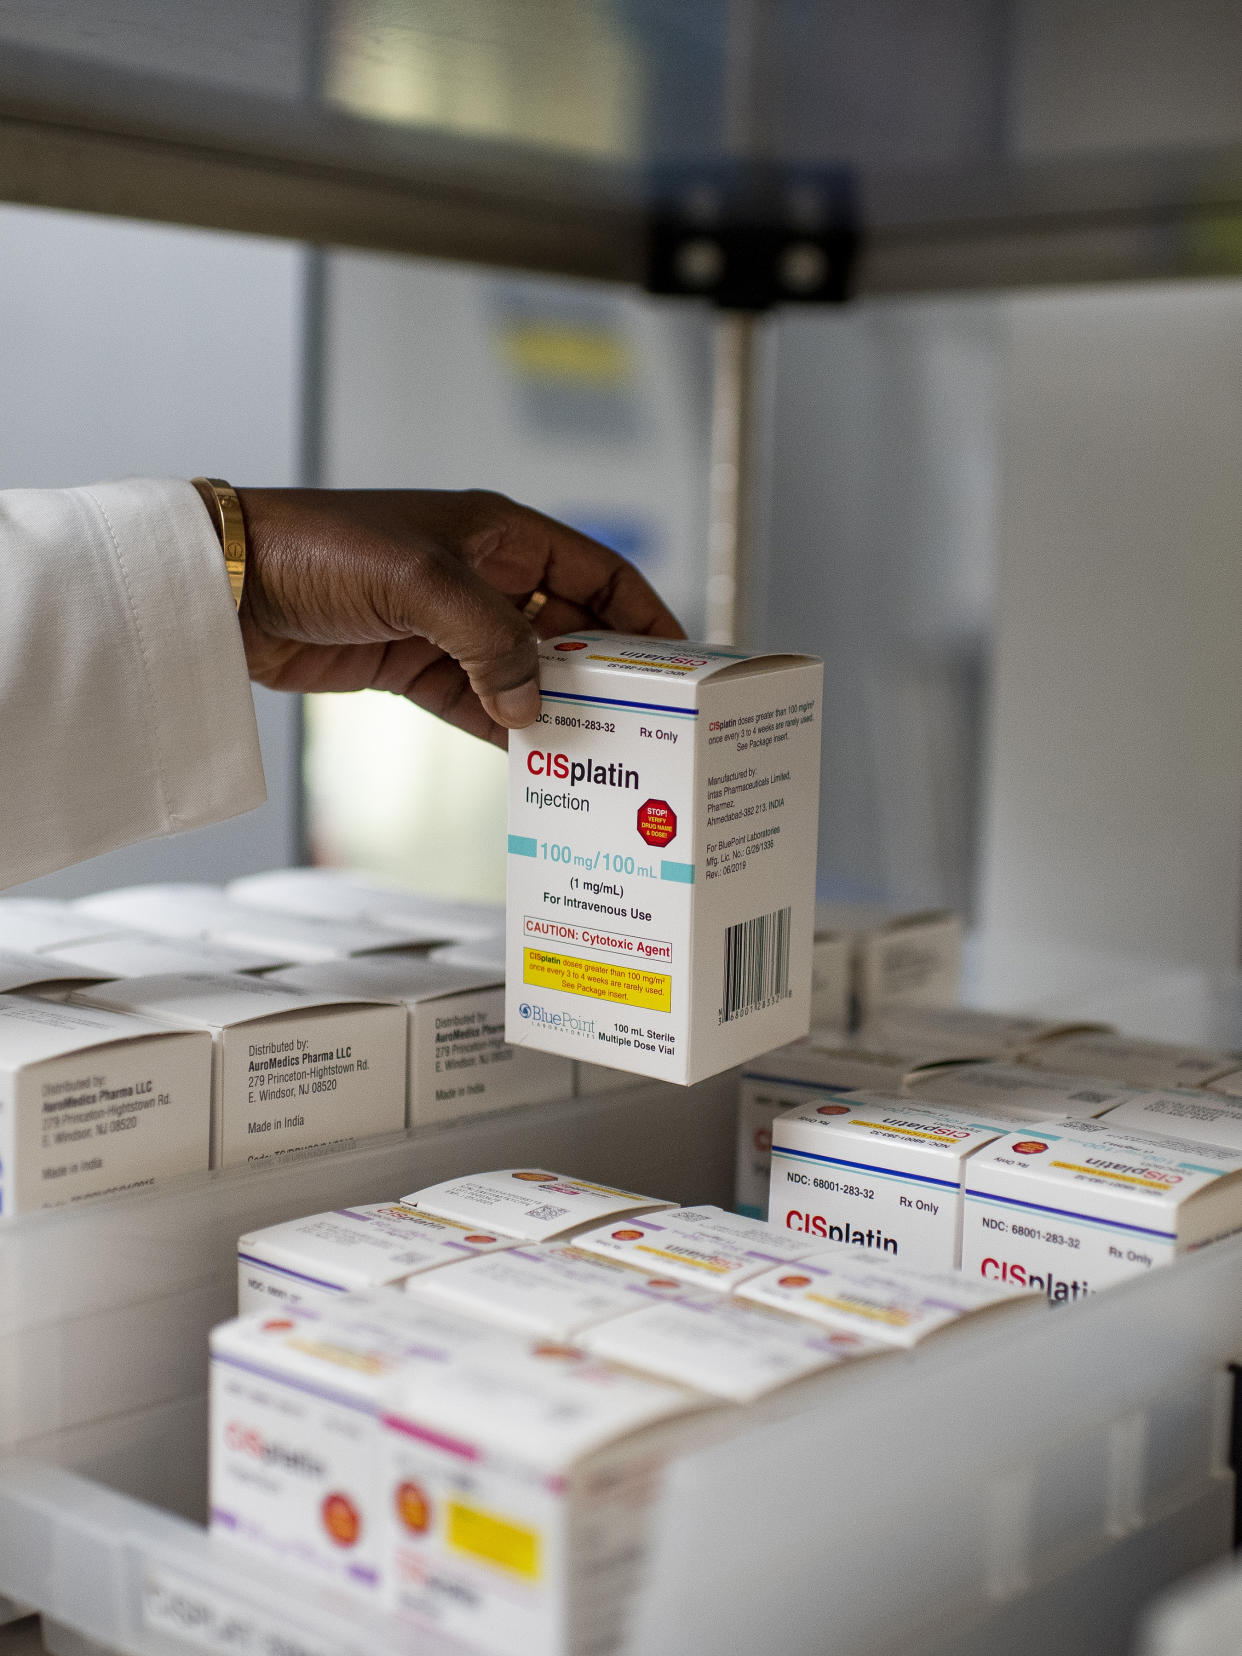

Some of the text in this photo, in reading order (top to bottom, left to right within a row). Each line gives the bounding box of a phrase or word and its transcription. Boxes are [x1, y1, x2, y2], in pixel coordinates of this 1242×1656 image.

[620, 652, 708, 666] CISplatin
[534, 713, 678, 744] DC: 68001-283-32 Rx Only
[709, 718, 736, 732] CISplatin
[738, 715, 754, 726] doses
[756, 710, 774, 723] greater
[776, 707, 786, 716] than
[788, 704, 798, 714] 100
[708, 732, 724, 744] once
[724, 730, 740, 742] every
[741, 728, 745, 737] 3
[746, 727, 752, 736] to
[752, 726, 756, 734] 4
[758, 722, 774, 734] weeks
[775, 720, 784, 730] are
[784, 717, 799, 730] rarely
[736, 742, 748, 752] See
[749, 736, 772, 750] Package
[526, 750, 640, 790] CISplatin
[708, 770, 748, 786] Manufactured
[526, 786, 590, 812] Injection
[707, 788, 723, 800] Intas
[724, 776, 770, 796] Pharmaceuticals
[647, 807, 668, 818] STOP!
[768, 798, 784, 810] INDIA
[642, 822, 656, 830] DRUG
[648, 816, 666, 824] VERIFY
[706, 826, 780, 854] For BluePoint Laboratories
[706, 857, 720, 868] Mfg.
[723, 860, 746, 876] 06/2019
[570, 877, 624, 898] (1 mg/mL)
[543, 892, 652, 922] For Intravenous Use
[526, 920, 670, 958] CAUTION: Cytotoxic Agent
[530, 952, 560, 964] CISplatin
[562, 960, 582, 969] doses
[584, 964, 608, 974] greater
[610, 968, 626, 978] than
[628, 972, 640, 980] 100
[529, 963, 545, 972] once
[546, 966, 564, 977] every
[587, 974, 608, 985] weeks
[610, 980, 622, 988] are
[624, 982, 644, 993] rarely
[562, 980, 628, 1000] See Package insert.
[532, 1005, 595, 1034] BluePoint
[532, 1021, 595, 1040] LABORATORIES
[598, 1032, 674, 1055] Multiple Dose Vial
[614, 1024, 675, 1042] 100 mL Sterile
[248, 1039, 308, 1056] Distributed by:
[248, 1046, 352, 1072] AuroMedics Pharma LLC
[248, 1059, 370, 1088] 279 Princeton-Hightstown Rd.
[100, 1085, 133, 1100] Pharma
[136, 1080, 152, 1095] LLC
[248, 1079, 336, 1103] E. Windsor, NJ 08520
[248, 1115, 304, 1134] Made in India
[883, 1118, 970, 1140] CISplatin
[1086, 1158, 1183, 1184] CISplatin
[787, 1172, 939, 1216] NDC: 68001-283-32 Rx Only
[982, 1217, 1153, 1268] NDC: 68001-283-32 Rx Only
